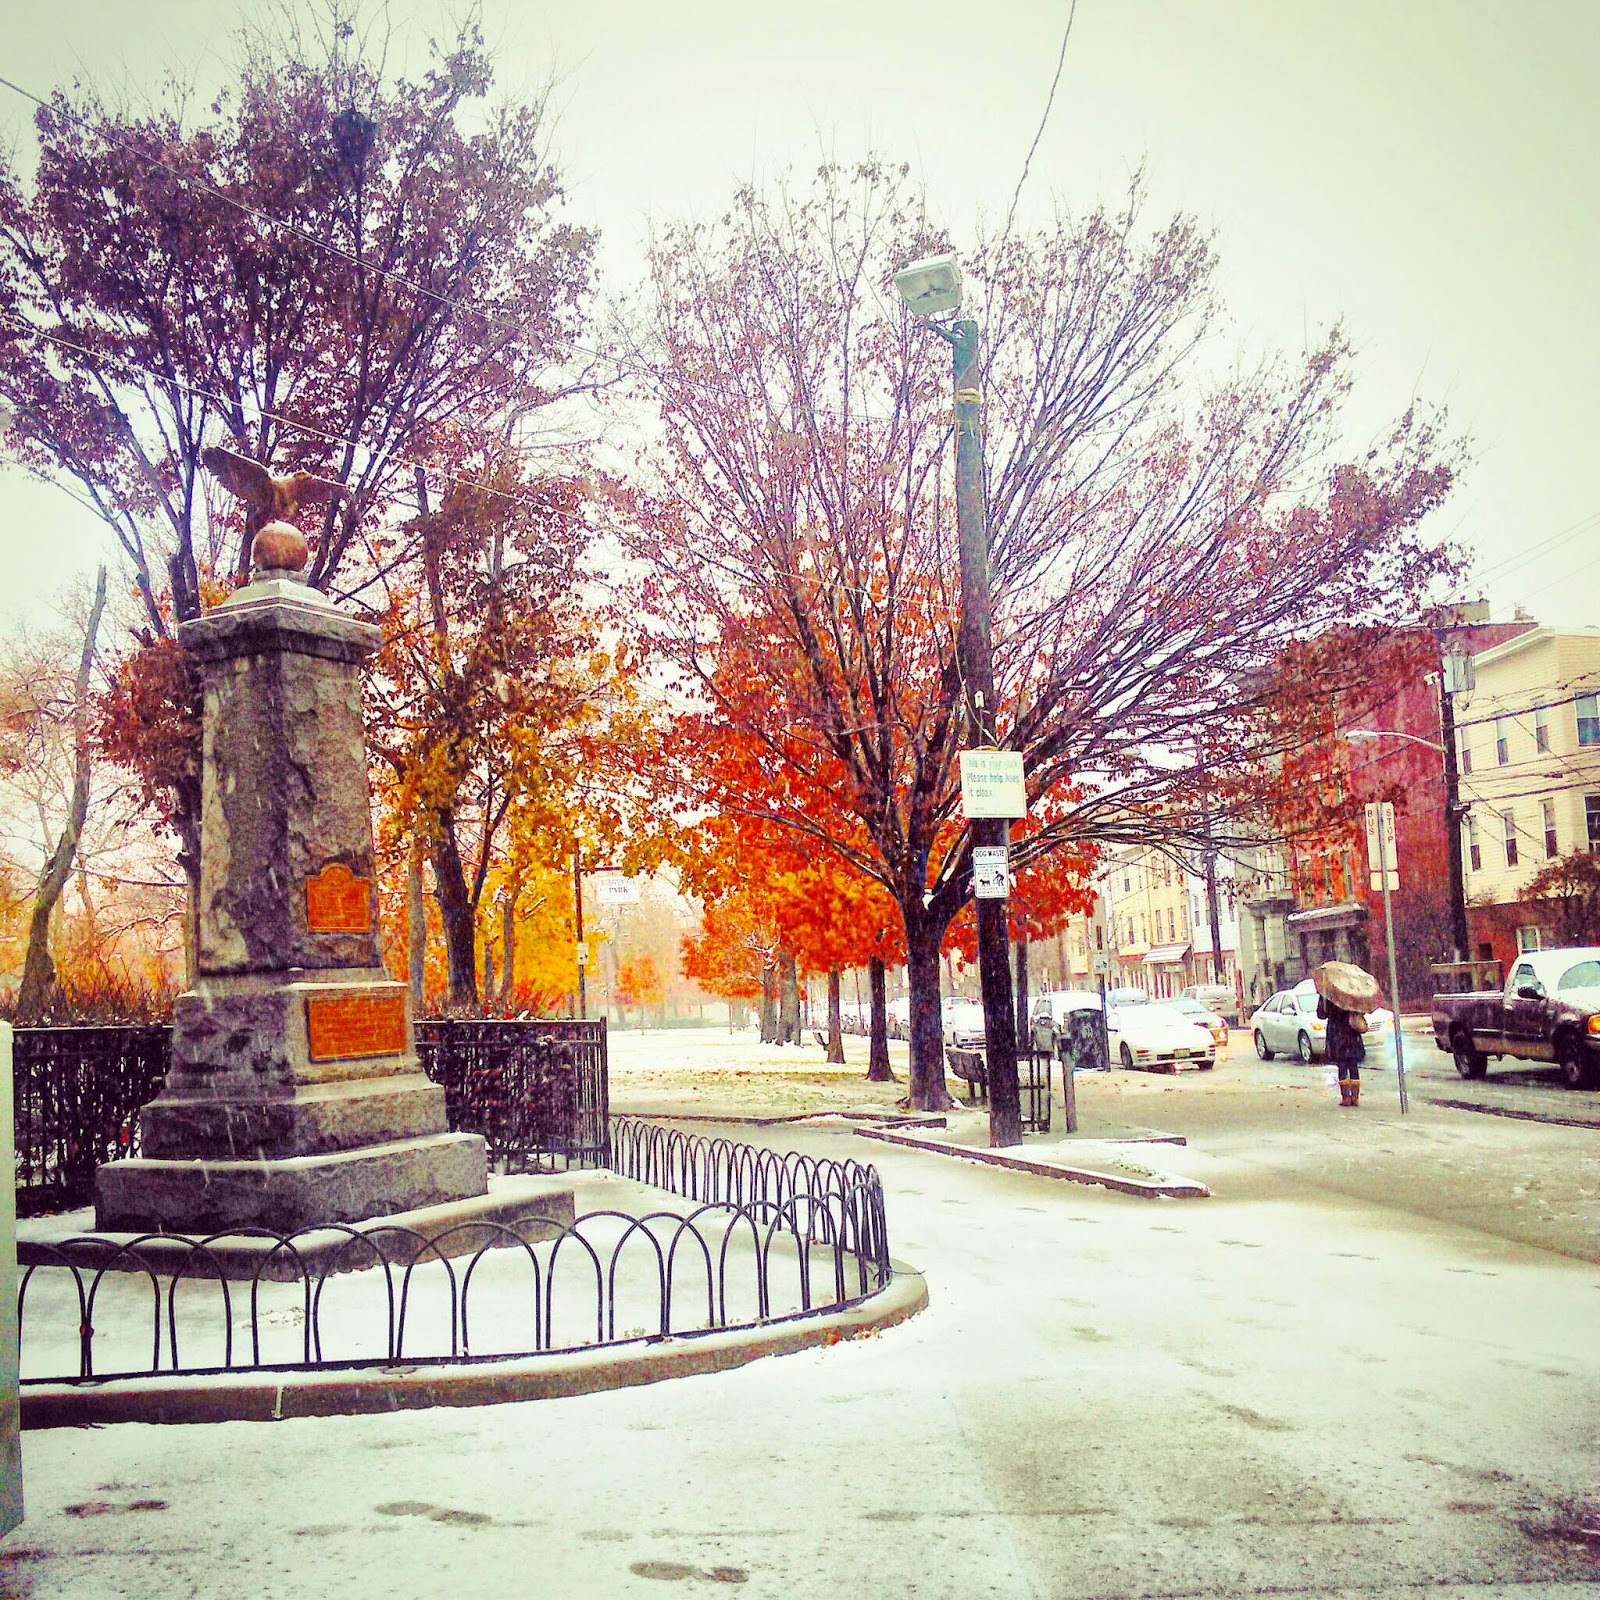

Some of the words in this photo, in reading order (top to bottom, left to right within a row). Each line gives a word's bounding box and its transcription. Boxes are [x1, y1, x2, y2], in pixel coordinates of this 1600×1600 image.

[966, 771, 988, 784] Please
[989, 772, 1004, 785] help
[1367, 809, 1375, 836] BUS
[1386, 808, 1394, 844] STOP
[975, 850, 987, 858] DOG
[987, 849, 1005, 857] WASTE
